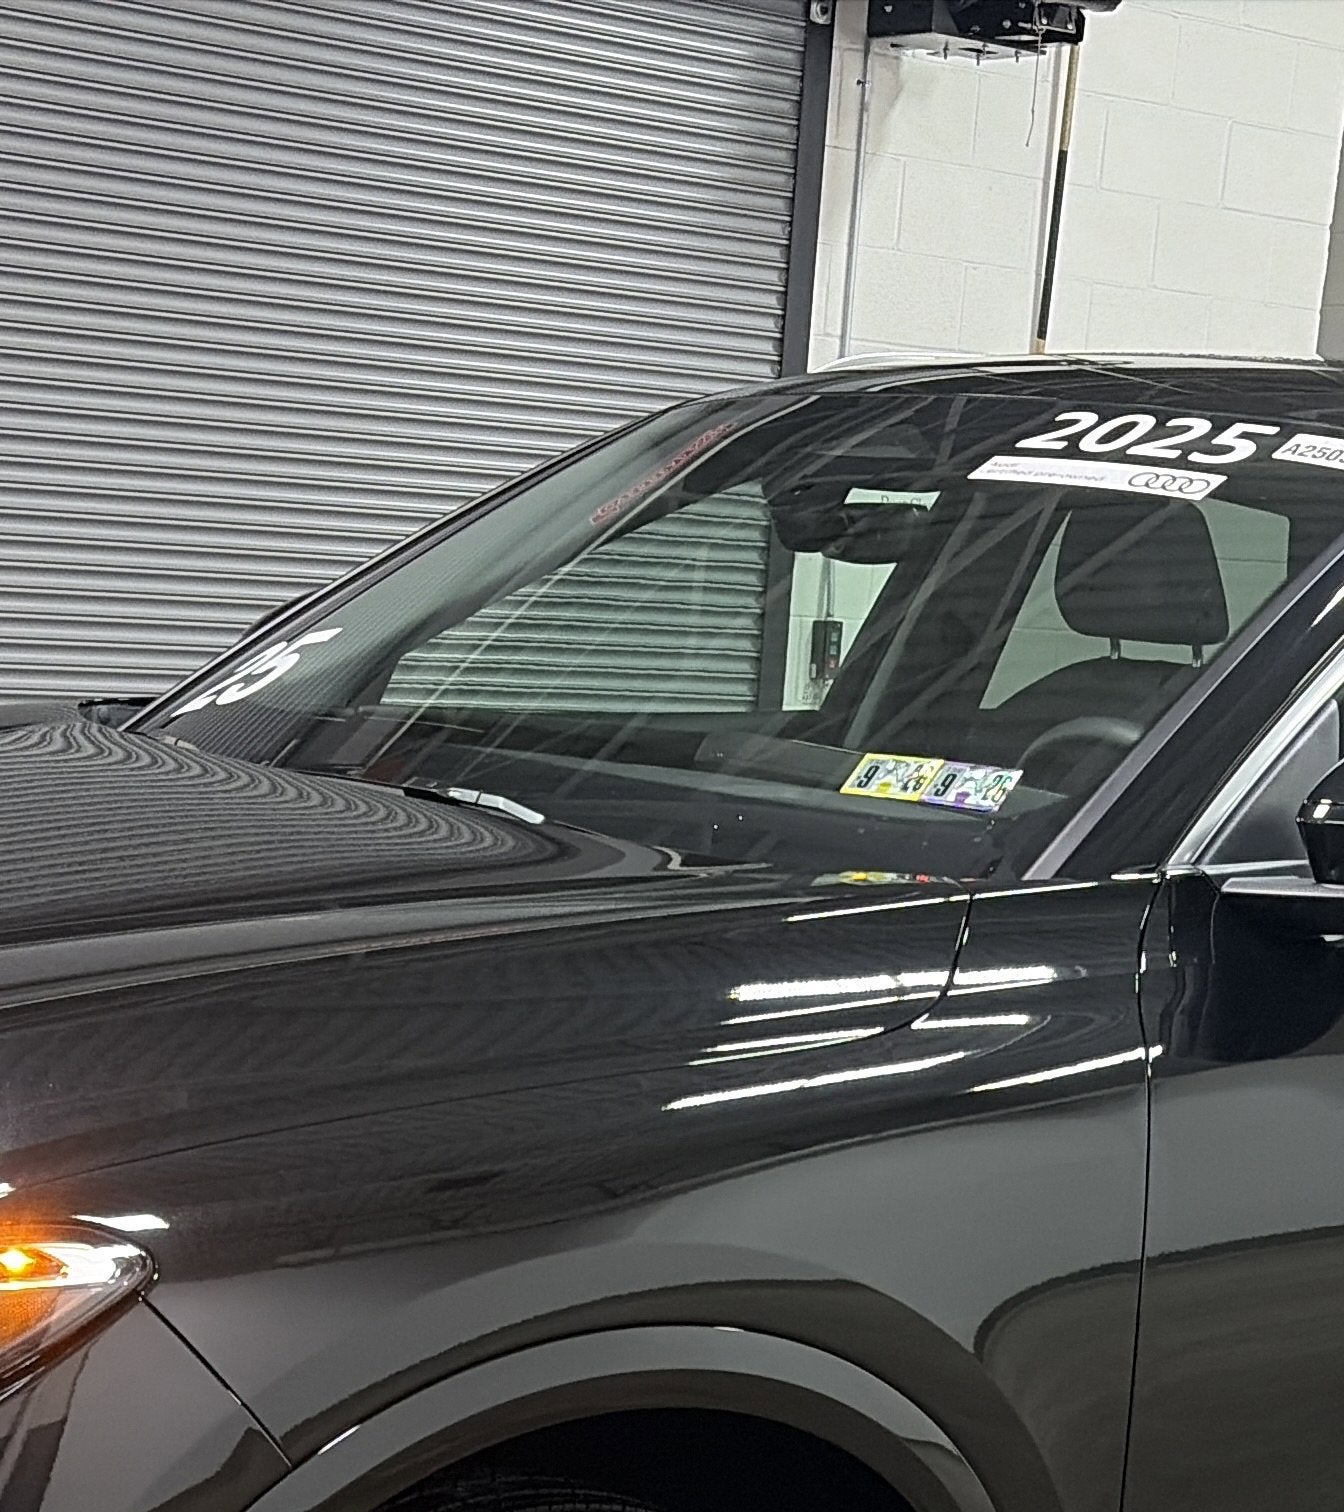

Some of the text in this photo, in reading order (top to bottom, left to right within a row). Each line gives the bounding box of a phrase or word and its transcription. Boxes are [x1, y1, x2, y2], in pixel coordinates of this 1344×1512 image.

[1014, 411, 1281, 464] 2025
[169, 627, 344, 718] 25
[856, 765, 881, 789] 9
[936, 773, 957, 797] 9
